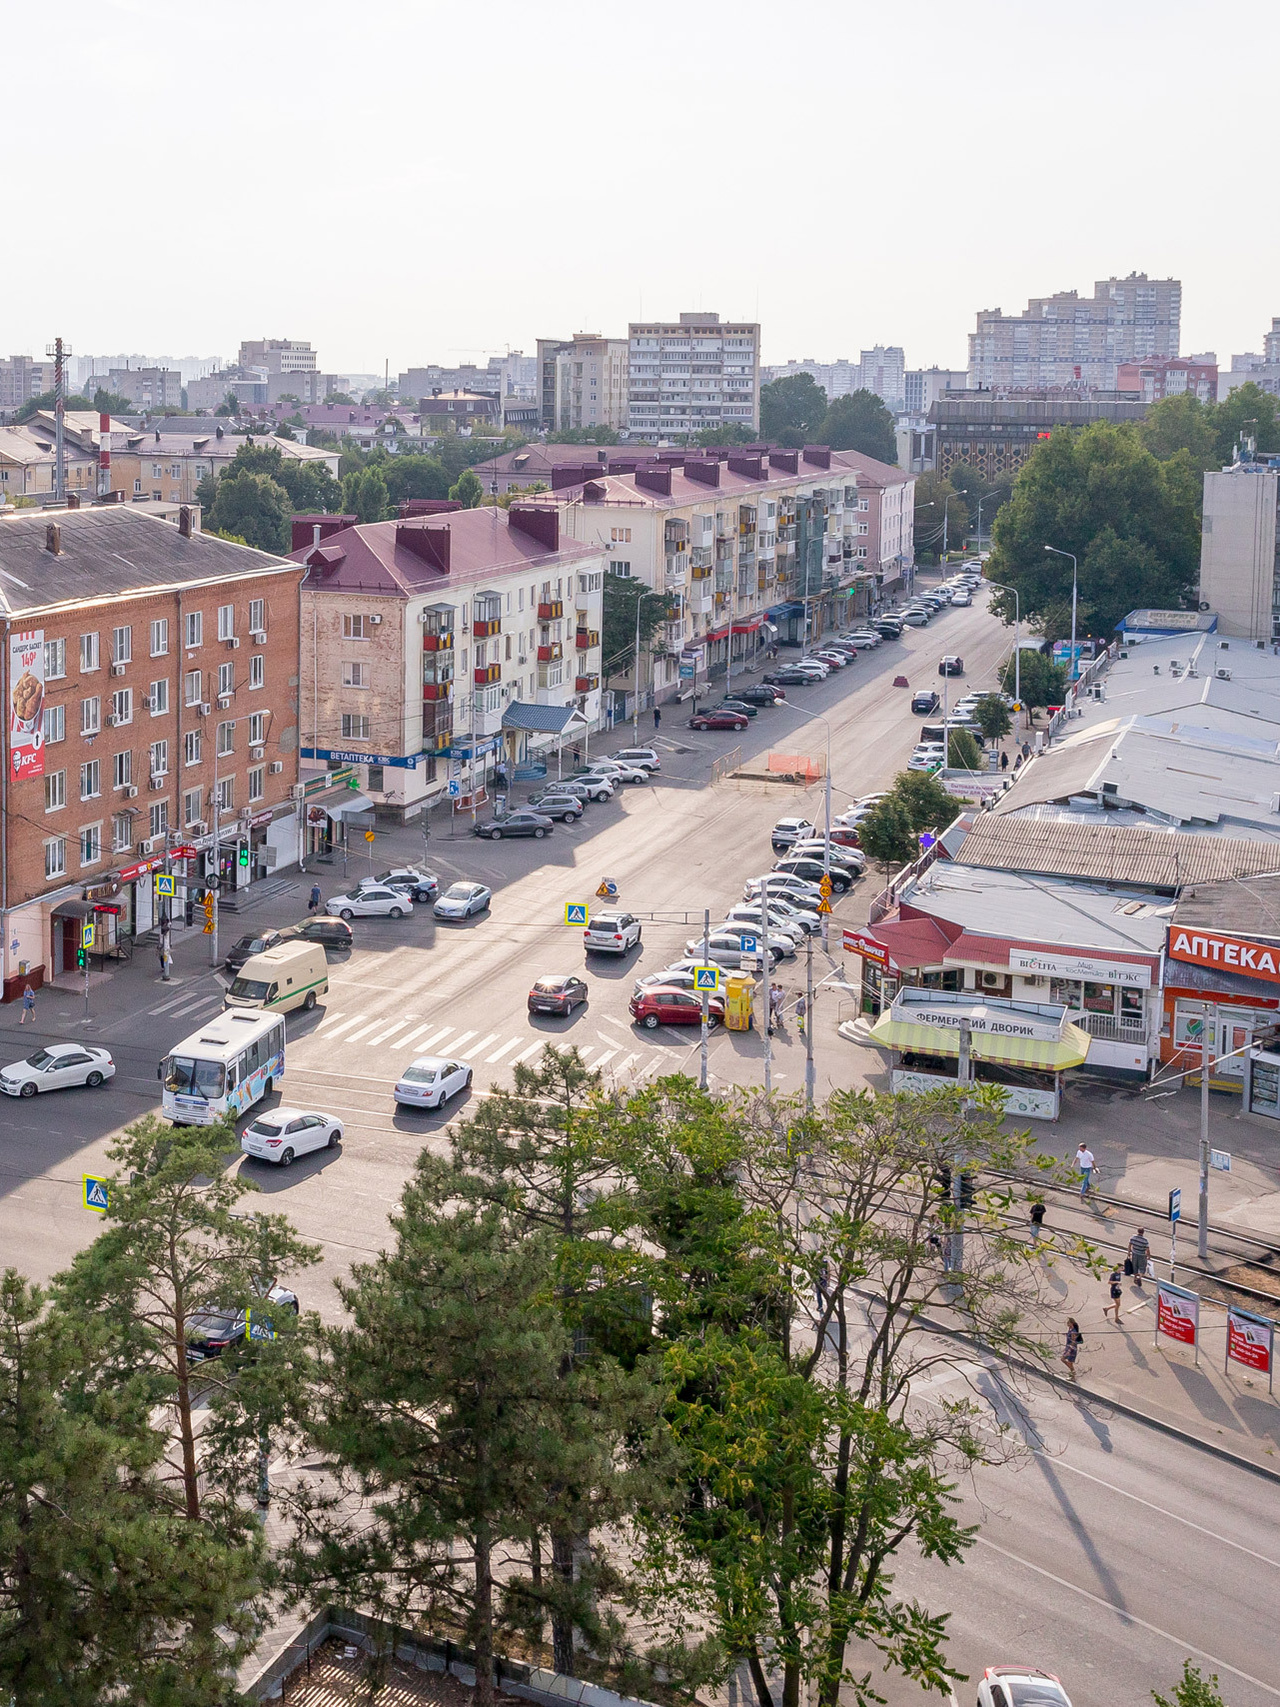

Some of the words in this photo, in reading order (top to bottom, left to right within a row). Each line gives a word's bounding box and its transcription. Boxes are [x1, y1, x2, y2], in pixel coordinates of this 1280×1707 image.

[21, 752, 36, 766] KFC
[330, 751, 374, 764] ВЕТАПТЕКА
[744, 938, 754, 950] P
[1173, 933, 1276, 974] АПТЕКА
[916, 1012, 987, 1029] ФЕРМЕРИЙ
[990, 1022, 1035, 1036] ДВОРИК
